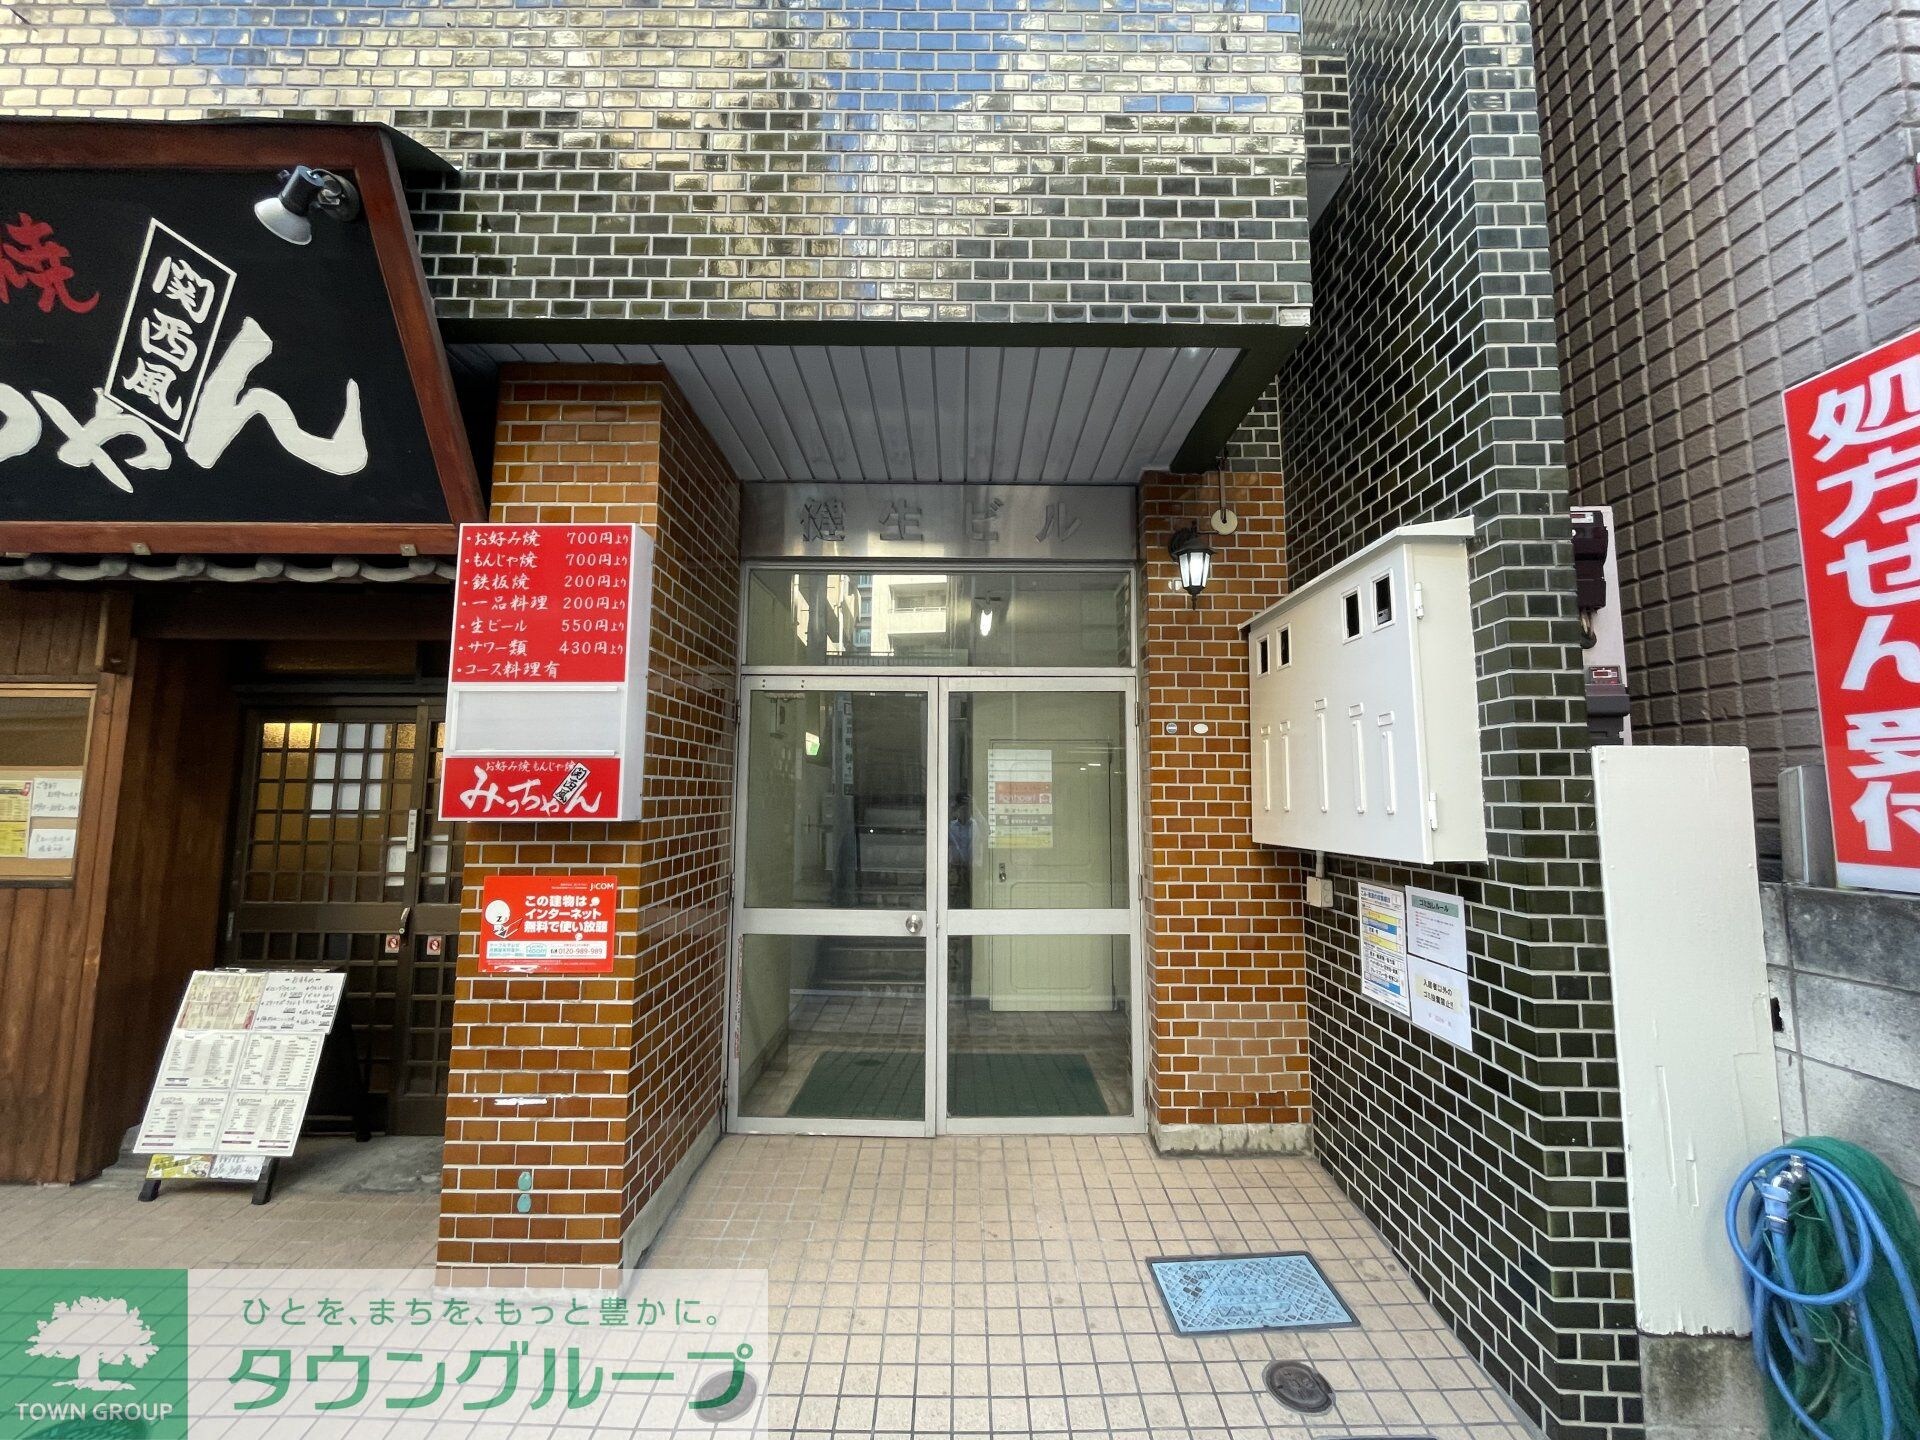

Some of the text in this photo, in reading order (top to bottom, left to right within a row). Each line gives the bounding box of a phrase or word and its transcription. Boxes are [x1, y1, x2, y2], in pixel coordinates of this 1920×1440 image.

[121, 256, 215, 421] 関西風
[566, 531, 629, 544] 700円より
[565, 553, 628, 567] 700円より
[564, 574, 627, 588] 200円より
[562, 596, 626, 610] 200円より
[561, 618, 625, 633] 550円より
[559, 640, 624, 655] 430円より
[486, 760, 530, 772] お好み焼
[459, 765, 602, 816] みっちゃん
[524, 895, 588, 908] この建物は
[524, 907, 602, 920] インターネット
[523, 920, 608, 934] 無料で使い放題
